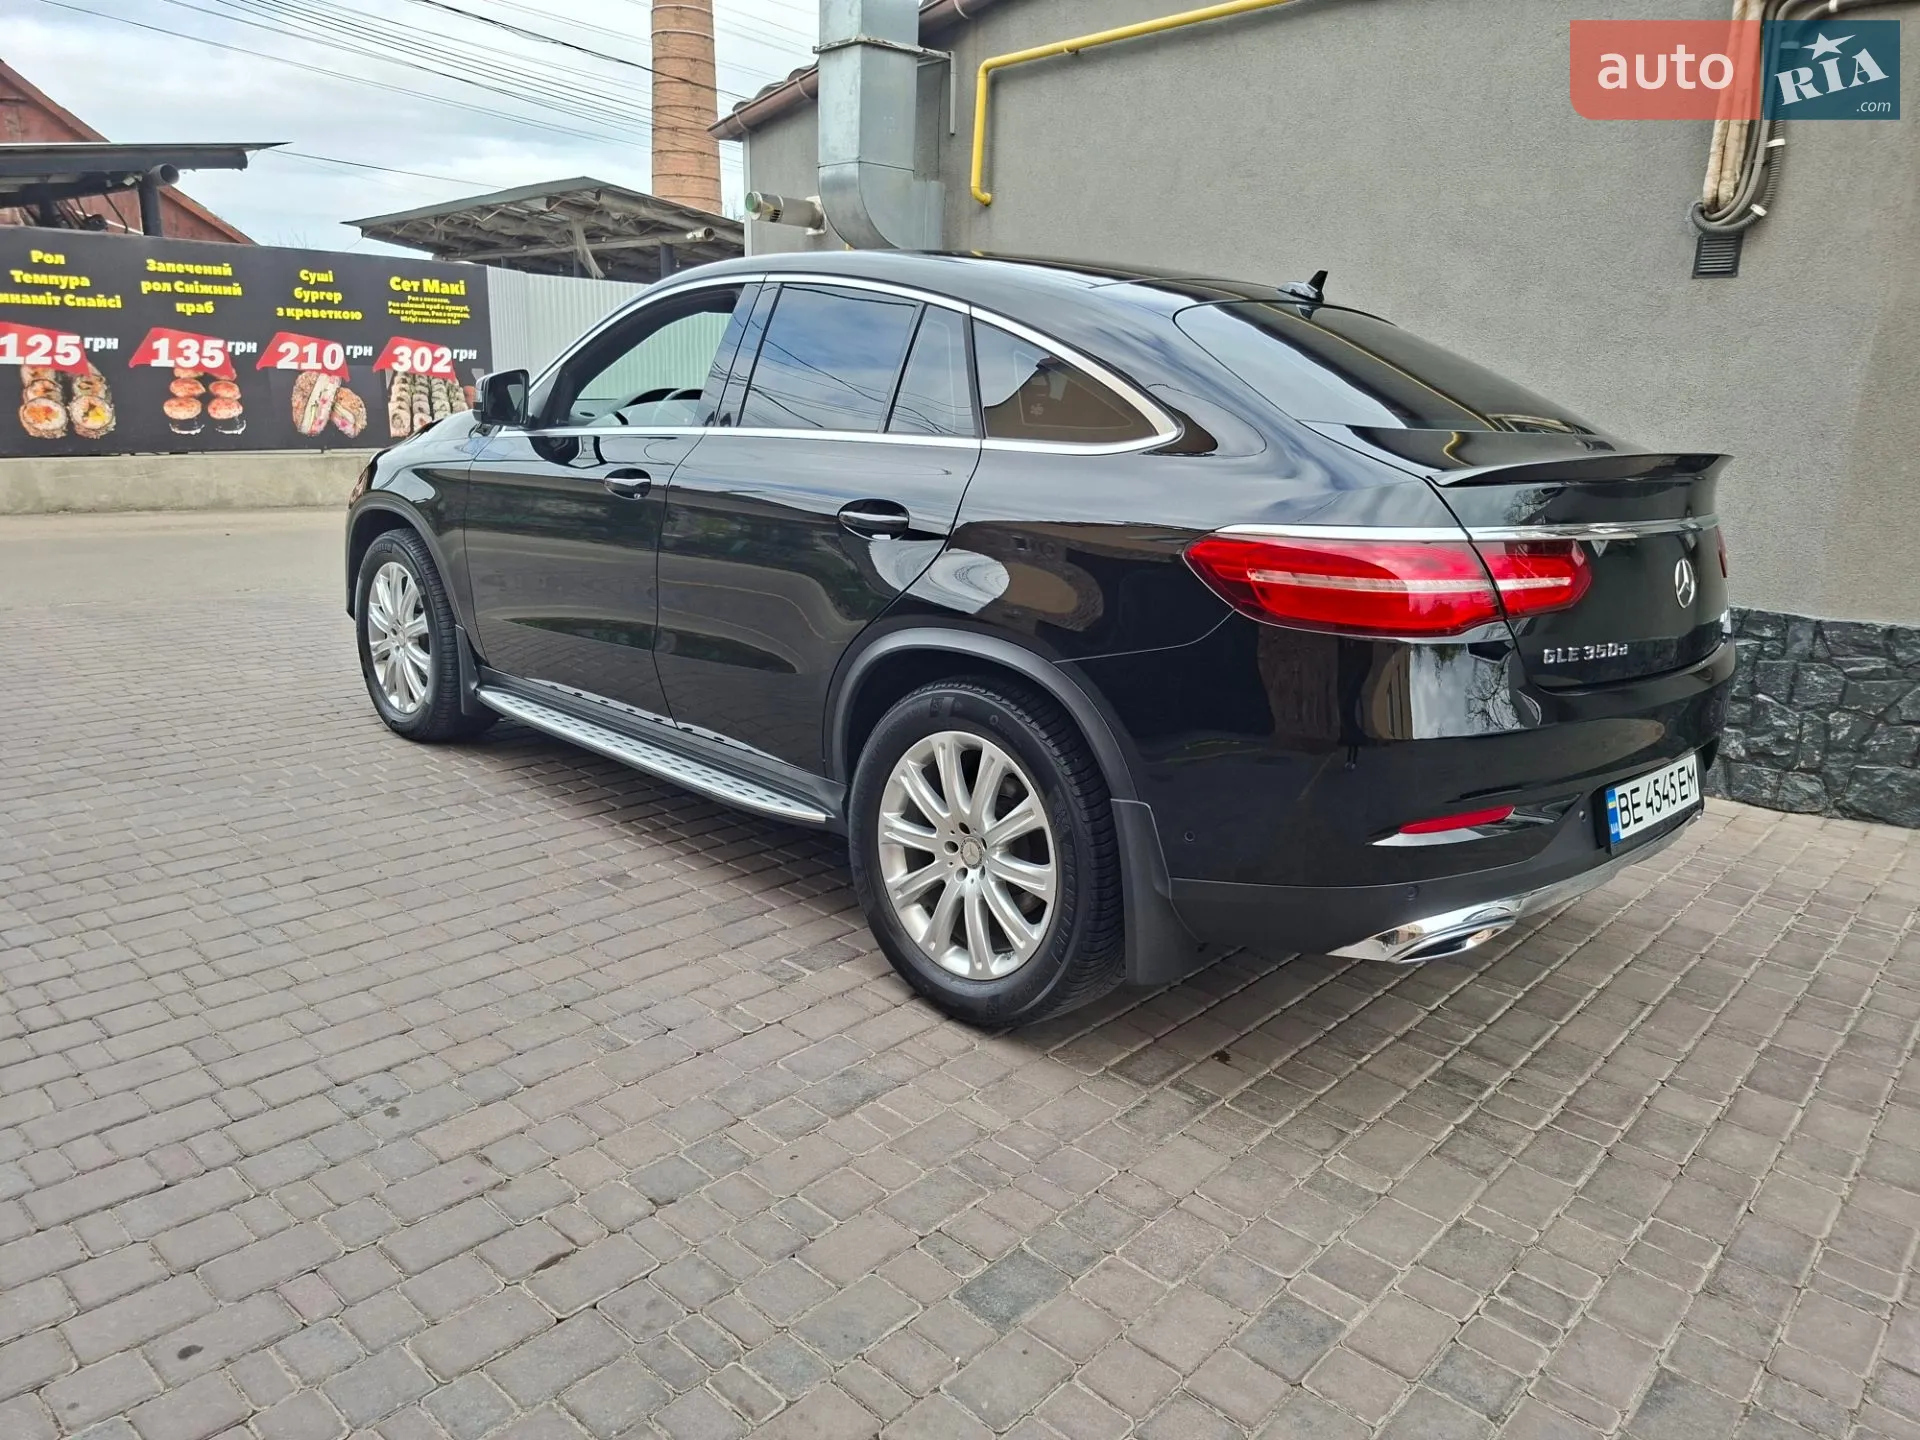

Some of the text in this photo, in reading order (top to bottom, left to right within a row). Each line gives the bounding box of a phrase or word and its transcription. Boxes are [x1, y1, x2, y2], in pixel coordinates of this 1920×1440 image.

[30, 250, 66, 265] Рол
[146, 259, 233, 277] Запечений
[299, 269, 334, 285] Суші
[10, 270, 91, 289] Темпура
[141, 281, 243, 296] рол Сніжний
[389, 276, 466, 296] Сет Макі
[0, 291, 122, 309] инаміт Спайсі
[293, 287, 343, 304] бургер
[175, 301, 215, 316] краб
[276, 307, 363, 321] з креветкою
[0, 333, 119, 366] 125 грн
[150, 338, 257, 368] 135 грн
[276, 342, 373, 371] 210 грн
[391, 345, 478, 373] 302 грн
[1543, 642, 1629, 665] GLE 350d
[1618, 761, 1697, 830] BE 4545 EM
